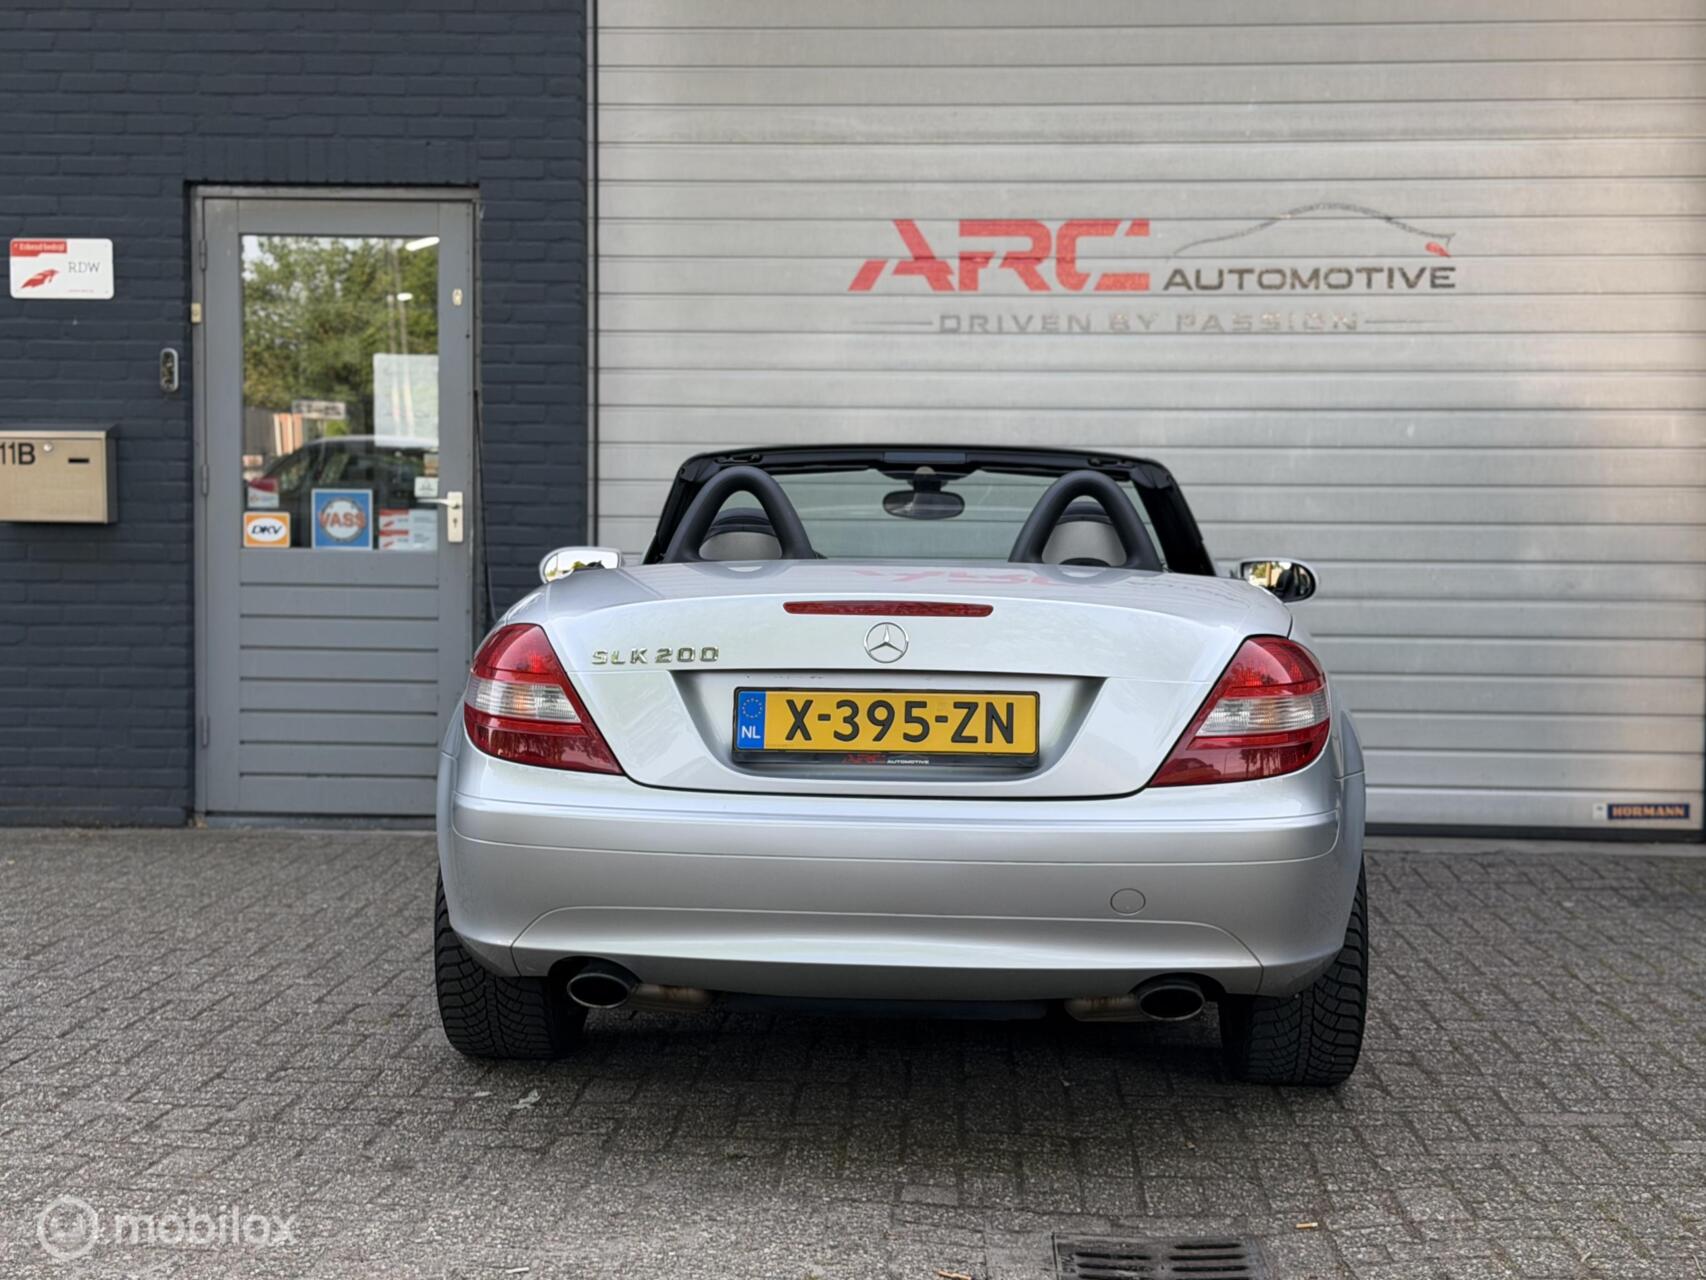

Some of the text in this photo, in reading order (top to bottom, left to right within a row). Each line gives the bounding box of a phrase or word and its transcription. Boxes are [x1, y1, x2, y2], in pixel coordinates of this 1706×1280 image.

[68, 261, 100, 273] RDW
[1163, 267, 1456, 292] AUTOMOTIVE
[939, 313, 1358, 334] DRIVEN BY PASSION
[0, 442, 36, 465] 11B
[591, 646, 719, 665] SLK 200
[785, 699, 1014, 744] X-395-ZN
[741, 726, 761, 739] NL
